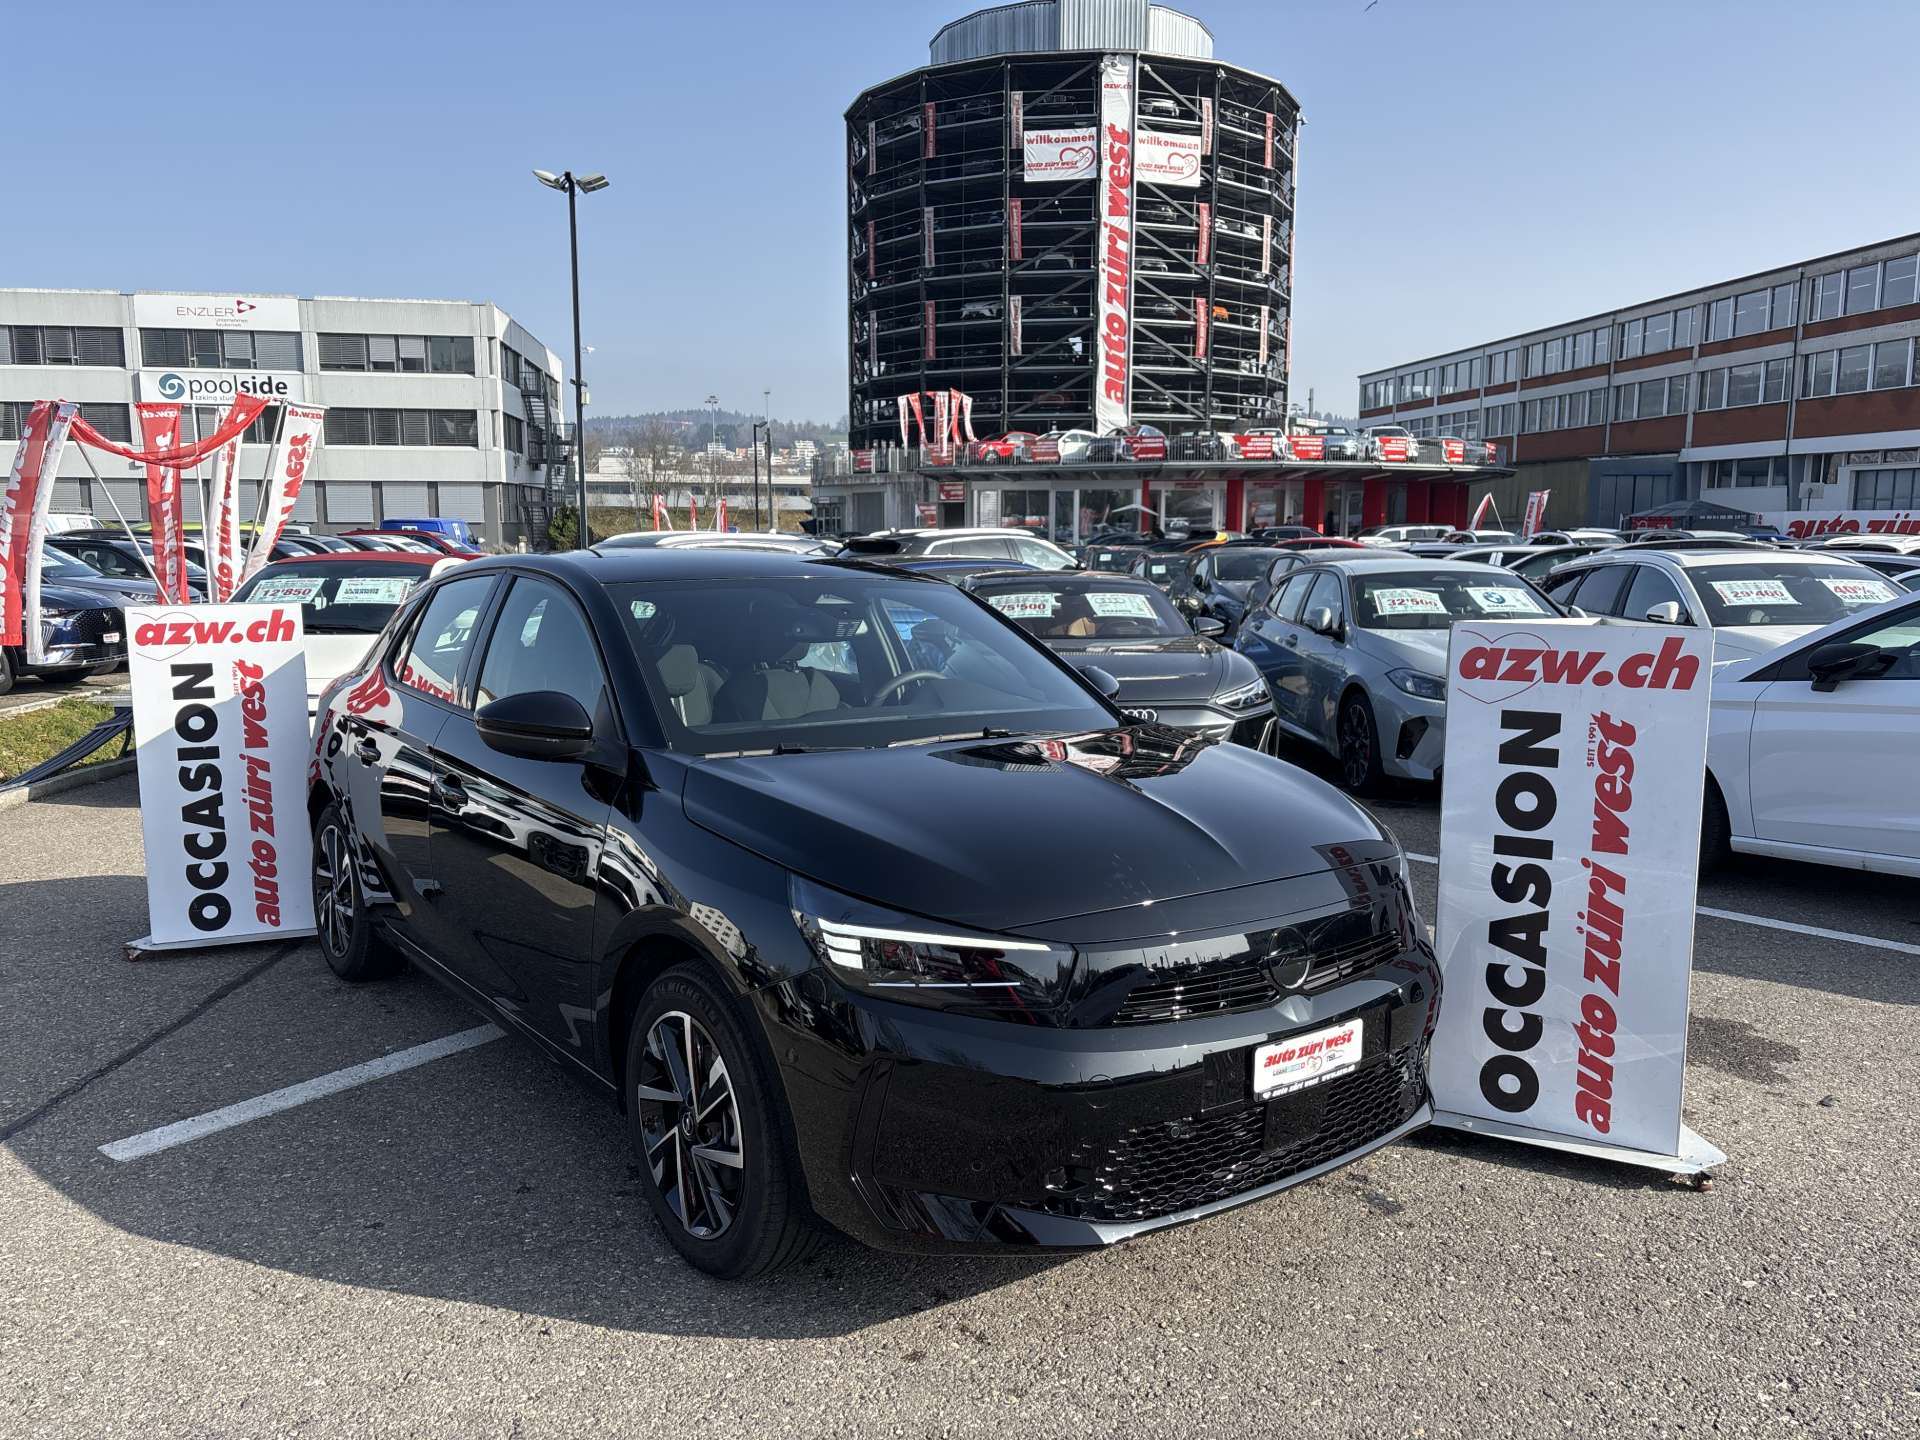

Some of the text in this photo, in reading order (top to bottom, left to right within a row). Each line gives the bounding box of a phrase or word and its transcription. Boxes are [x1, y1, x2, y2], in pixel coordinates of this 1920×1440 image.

[1103, 81, 1132, 90] azw.ch
[1026, 133, 1095, 145] willkommen
[1138, 136, 1199, 150] willkommen
[1100, 122, 1131, 405] auto züri west
[176, 306, 235, 317] ENZLER
[189, 375, 288, 400] poolside
[6, 425, 33, 491] west
[216, 502, 233, 559] züri
[1785, 513, 1860, 538] auto
[263, 588, 312, 597] 12'850
[1833, 585, 1876, 595] 40%
[135, 609, 296, 646] azw.ch
[1459, 637, 1700, 690] azw.ch
[1586, 721, 1597, 767] SEIT 1991
[170, 663, 232, 932] OCCASION
[233, 659, 281, 927] auto züri west
[1479, 710, 1562, 1113] OCCASION
[1572, 711, 1637, 1134] auto züri west
[1264, 1048, 1297, 1068] auto
[1296, 1038, 1324, 1058] züri
[1326, 1029, 1354, 1049] west
